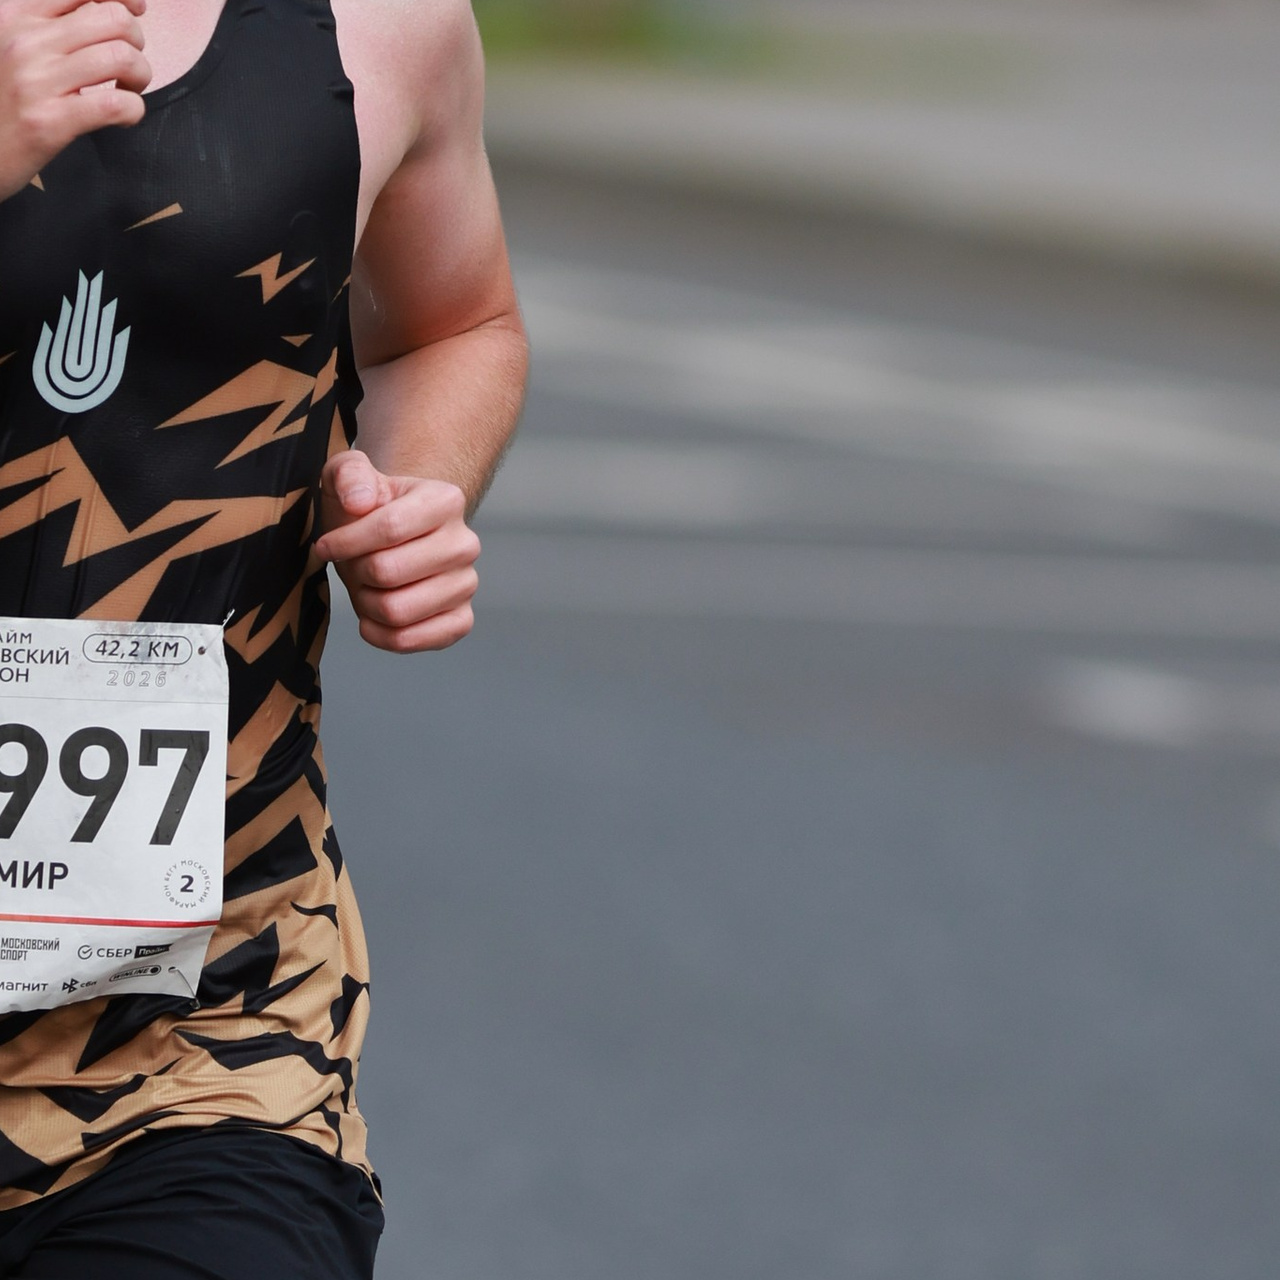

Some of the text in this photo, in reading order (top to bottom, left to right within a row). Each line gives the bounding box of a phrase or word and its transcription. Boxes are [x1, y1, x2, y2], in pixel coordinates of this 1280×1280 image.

[95, 639, 179, 660] 42,2 КМ
[106, 670, 167, 687] 2026
[180, 875, 194, 893] 2
[1, 937, 60, 951] МОСКОВСКИЙ
[0, 949, 28, 961] СПОРТ
[97, 947, 133, 958] СБЕР
